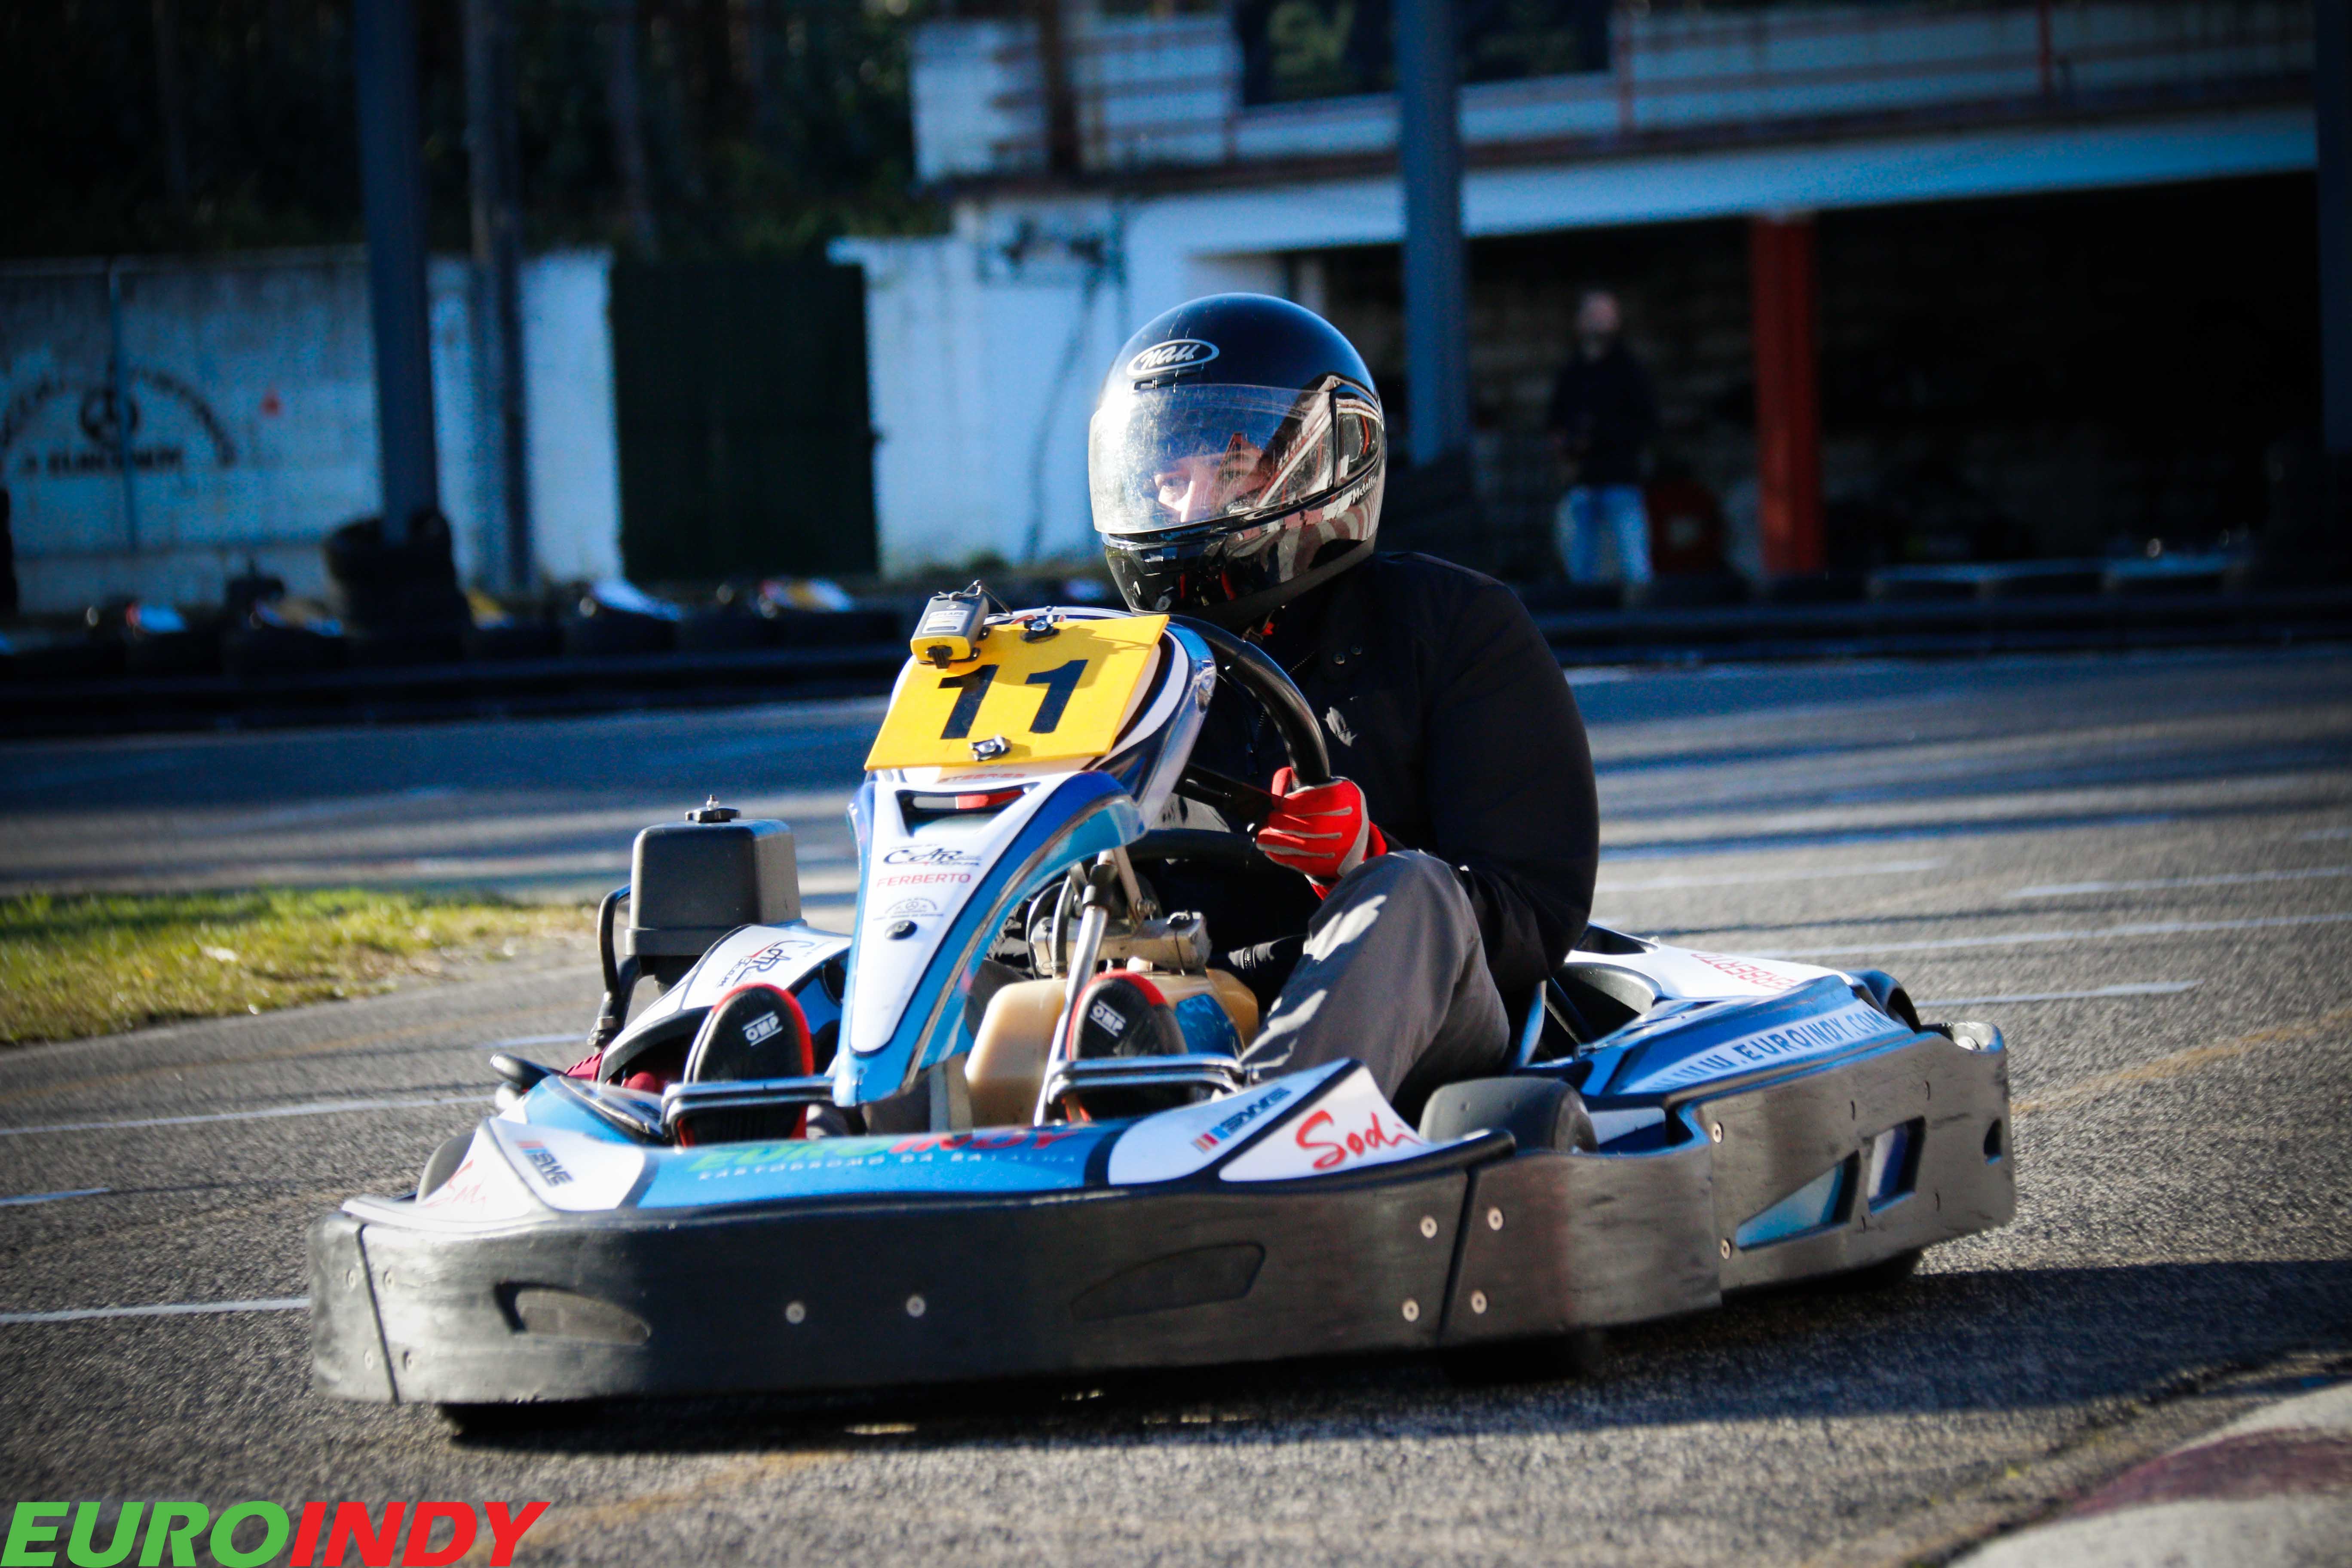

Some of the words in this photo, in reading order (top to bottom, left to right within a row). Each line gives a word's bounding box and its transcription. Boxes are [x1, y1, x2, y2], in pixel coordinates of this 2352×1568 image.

[938, 659, 1088, 740] 11
[877, 873, 971, 887] FERBERTO
[745, 1015, 780, 1041] OMP
[1092, 1004, 1124, 1032] OMP
[1295, 1110, 1424, 1170] Sodi
